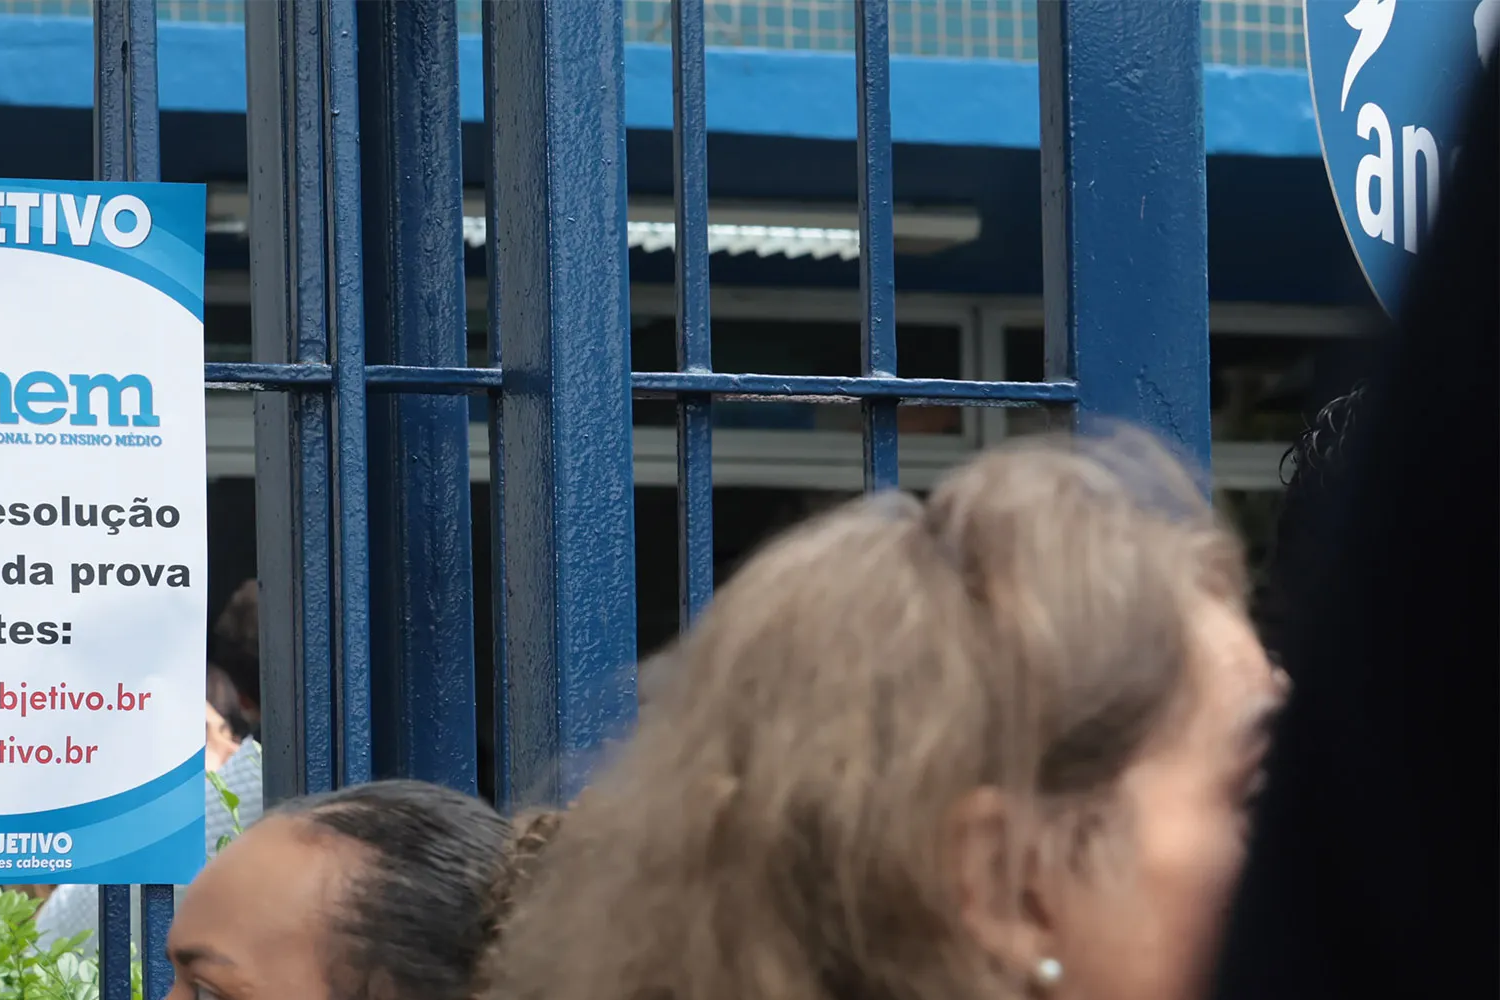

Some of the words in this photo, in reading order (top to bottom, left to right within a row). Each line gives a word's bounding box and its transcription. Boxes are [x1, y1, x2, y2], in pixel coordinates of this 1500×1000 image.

[1355, 102, 1452, 255] an
[35, 433, 57, 445] DO
[60, 434, 112, 446] ENSINO
[115, 432, 163, 448] MÉDIO
[1, 554, 54, 586] da
[71, 560, 192, 593] prova
[16, 855, 73, 871] cabeças
